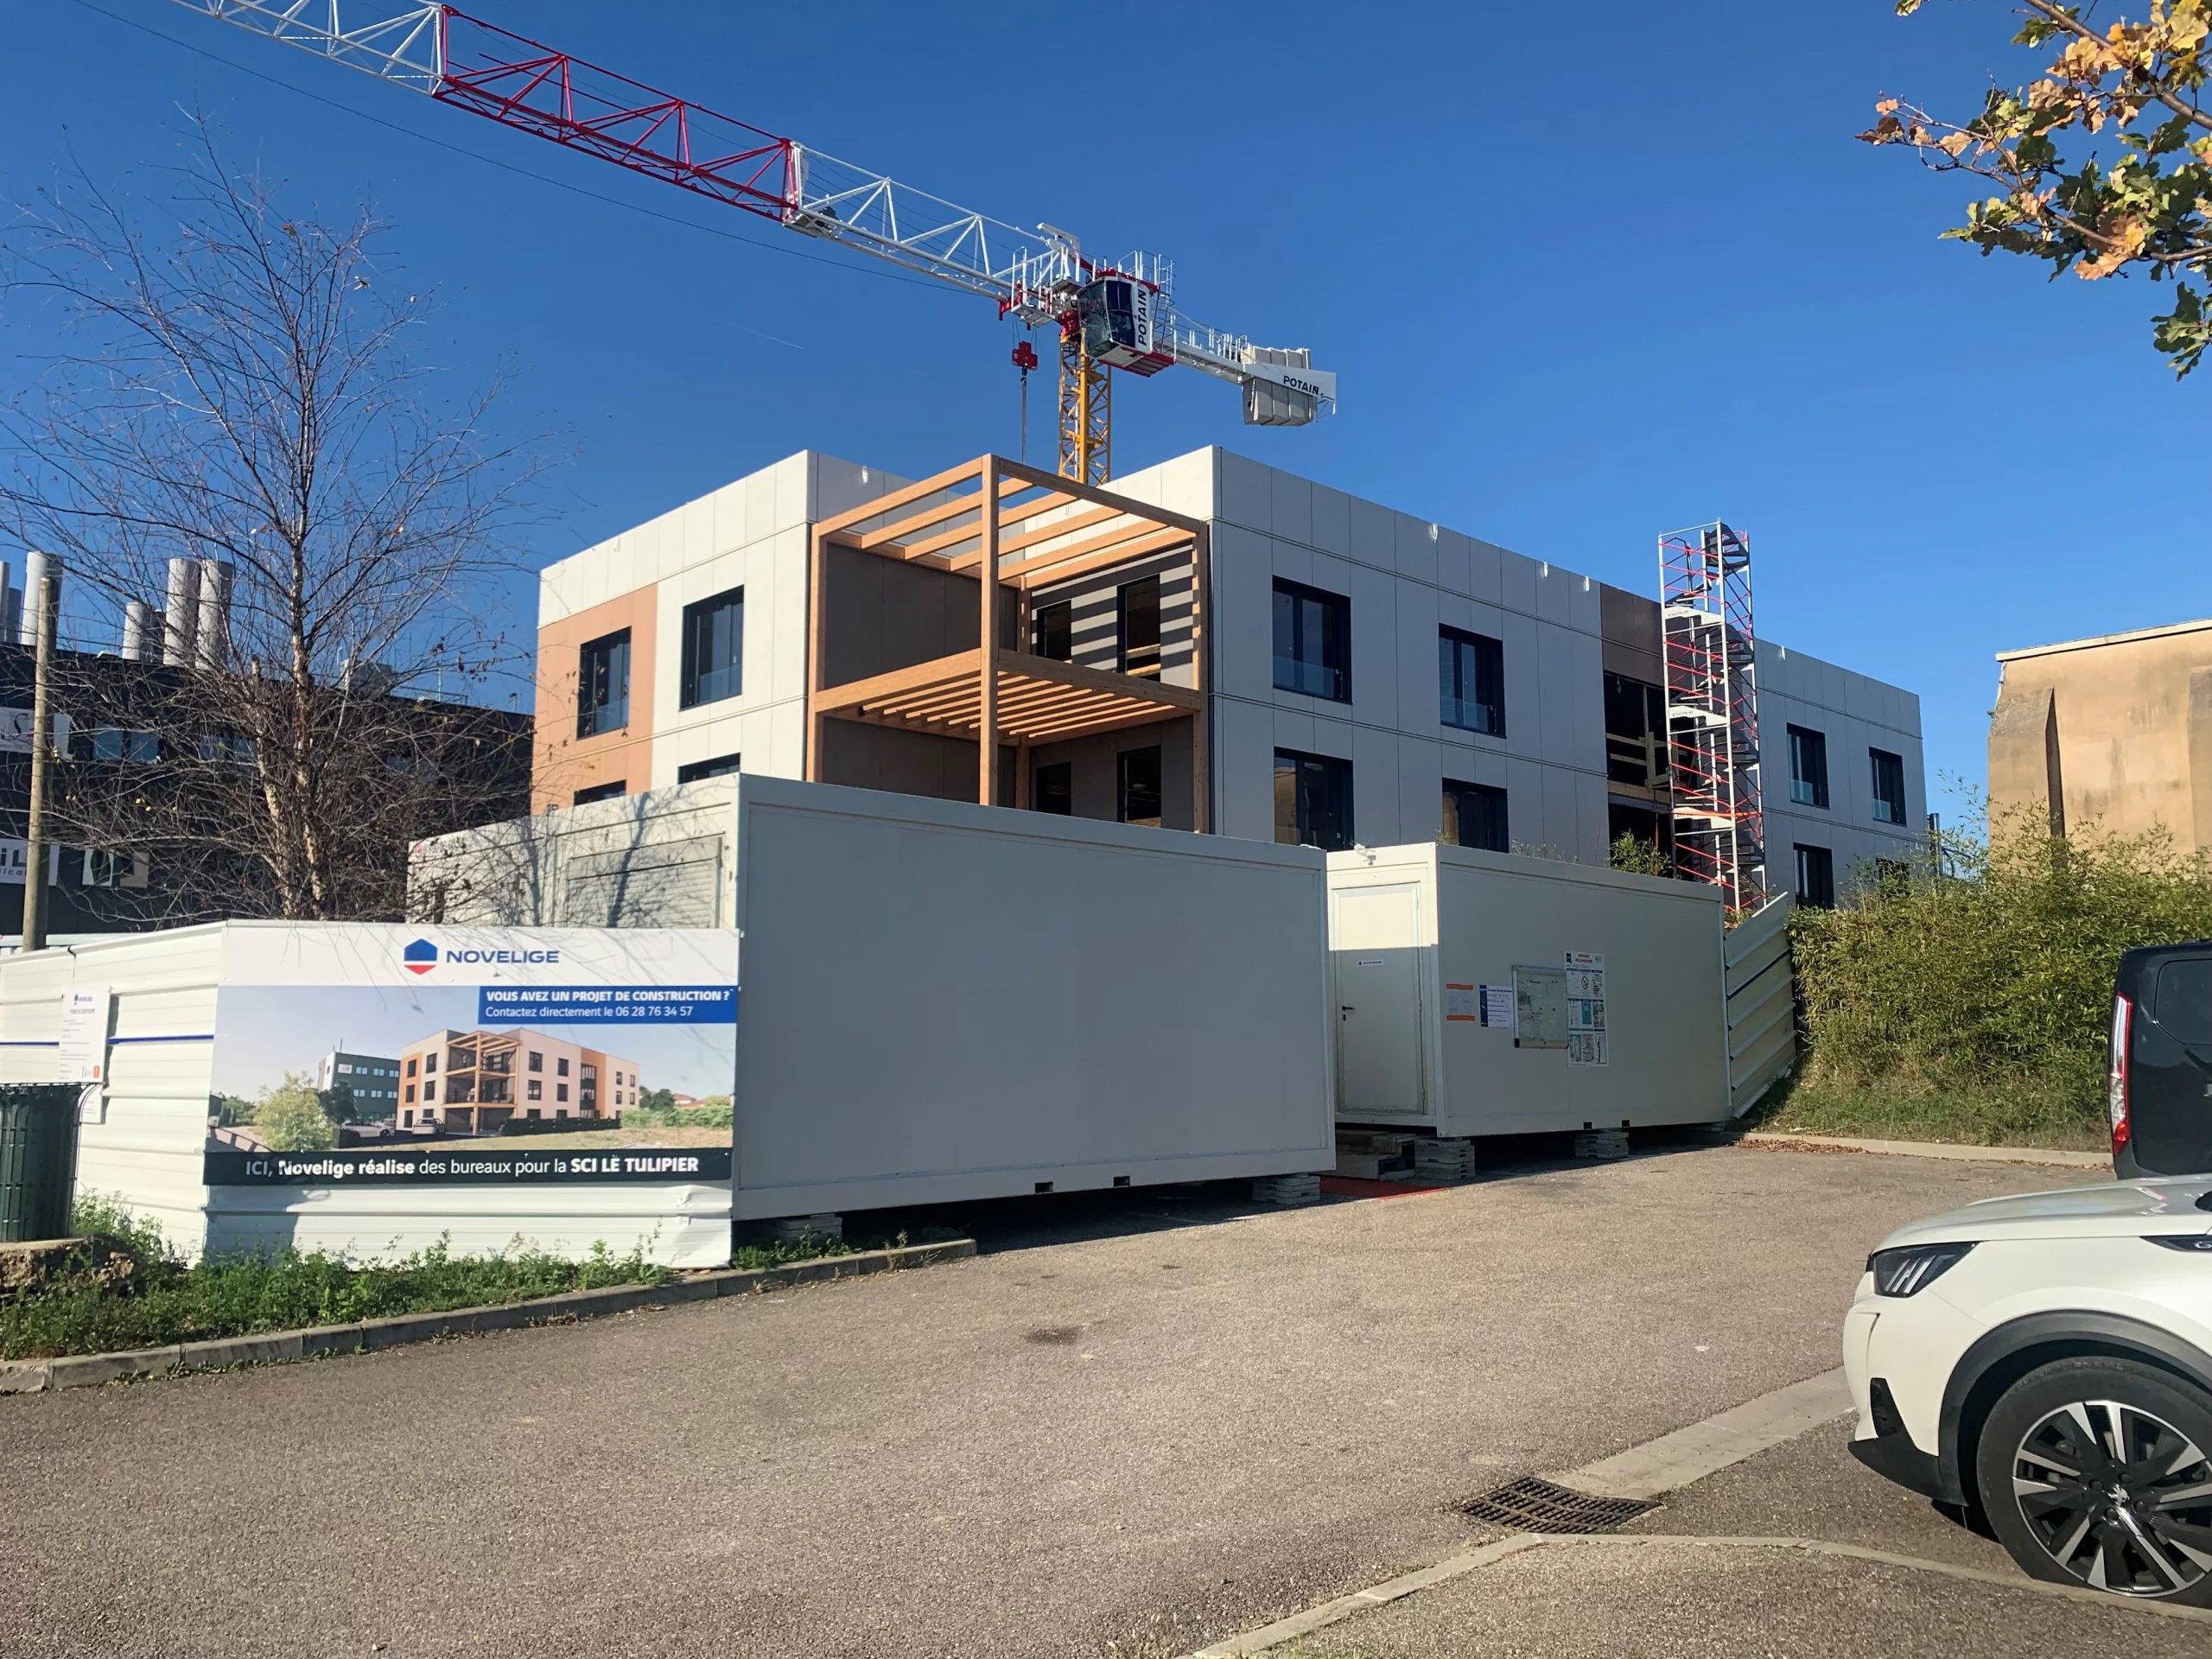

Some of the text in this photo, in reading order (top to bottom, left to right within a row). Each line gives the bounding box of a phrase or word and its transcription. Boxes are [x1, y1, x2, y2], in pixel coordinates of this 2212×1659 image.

[1138, 289, 1147, 346] POTAIN
[1283, 375, 1319, 395] POTAIN
[446, 950, 560, 963] NOVELIGE
[486, 991, 518, 1001] VOUS
[520, 991, 549, 1001] AVEZ
[551, 991, 569, 1001] UN
[572, 991, 613, 1002] PROJET
[615, 991, 630, 1001] DE
[632, 990, 721, 1001] CONSTRUCTION
[486, 1006, 693, 1017] Contactez directement le 06 28 76 34 57
[245, 1160, 273, 1177] ICI,
[278, 1160, 354, 1179] Novelige
[359, 1159, 415, 1174] réalise
[419, 1160, 445, 1174] des
[450, 1159, 511, 1173] bureaux
[515, 1161, 550, 1177] pour
[554, 1159, 566, 1173] la
[570, 1159, 596, 1173] SCI
[625, 1158, 699, 1172] TULIPIER
